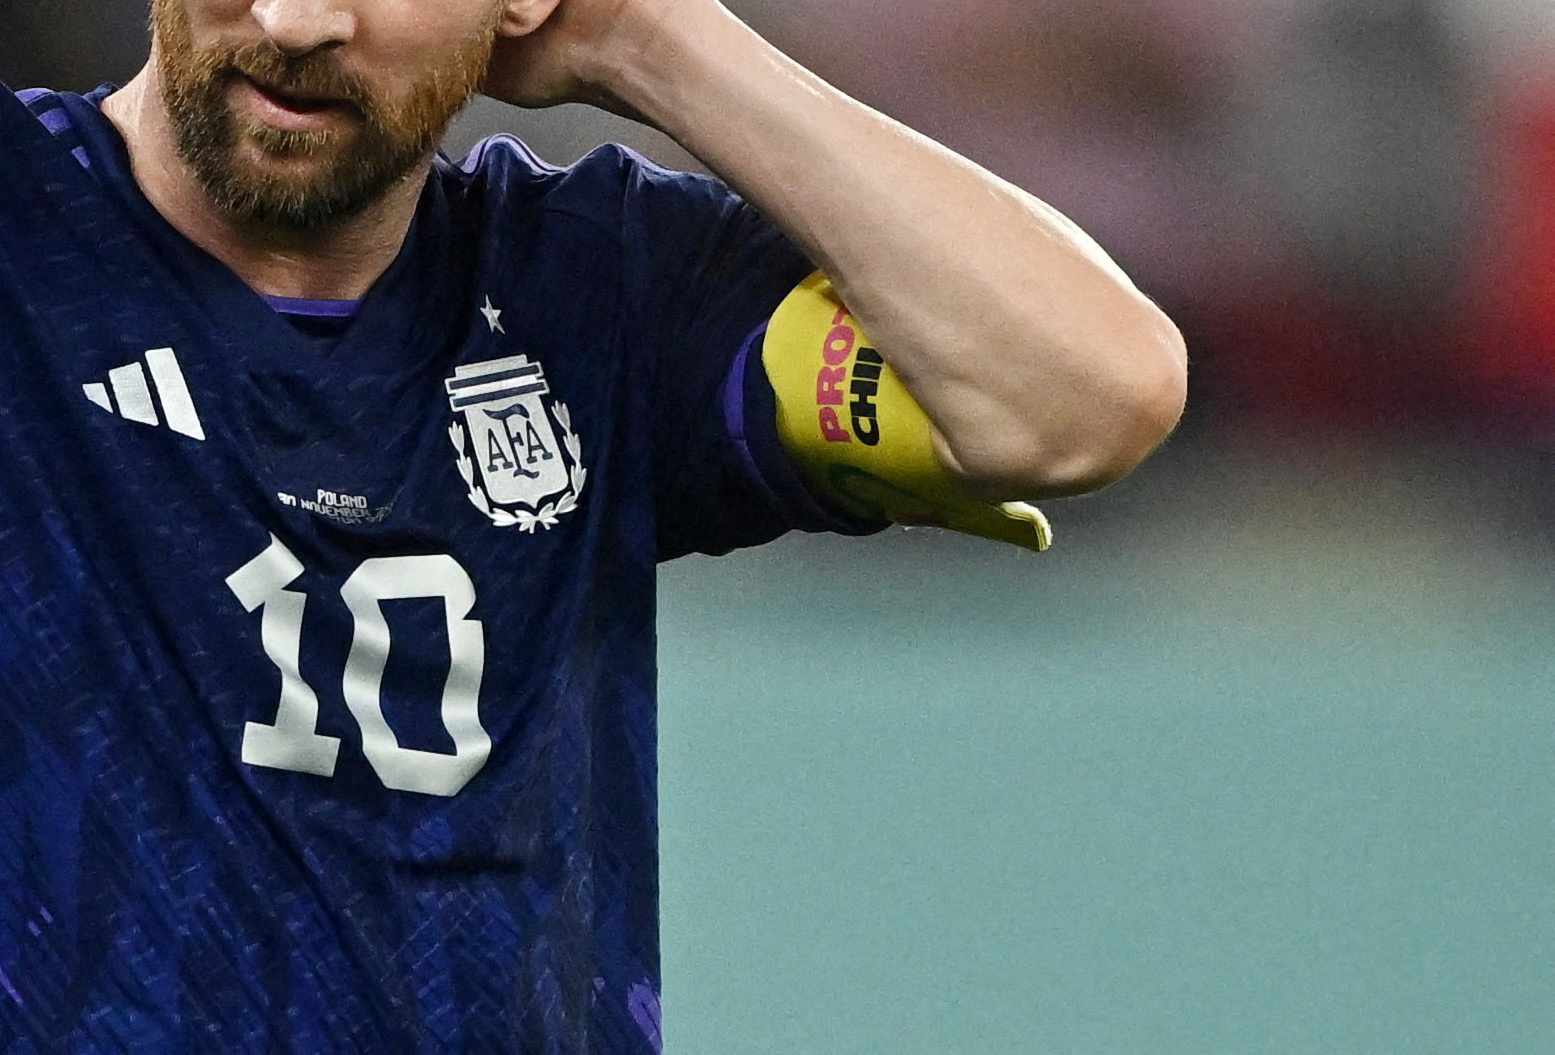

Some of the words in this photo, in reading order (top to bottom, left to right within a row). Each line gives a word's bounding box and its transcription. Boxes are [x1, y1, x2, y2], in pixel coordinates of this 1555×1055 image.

[482, 403, 554, 479] AFA
[317, 489, 367, 508] POLAND
[225, 530, 492, 797] 10
